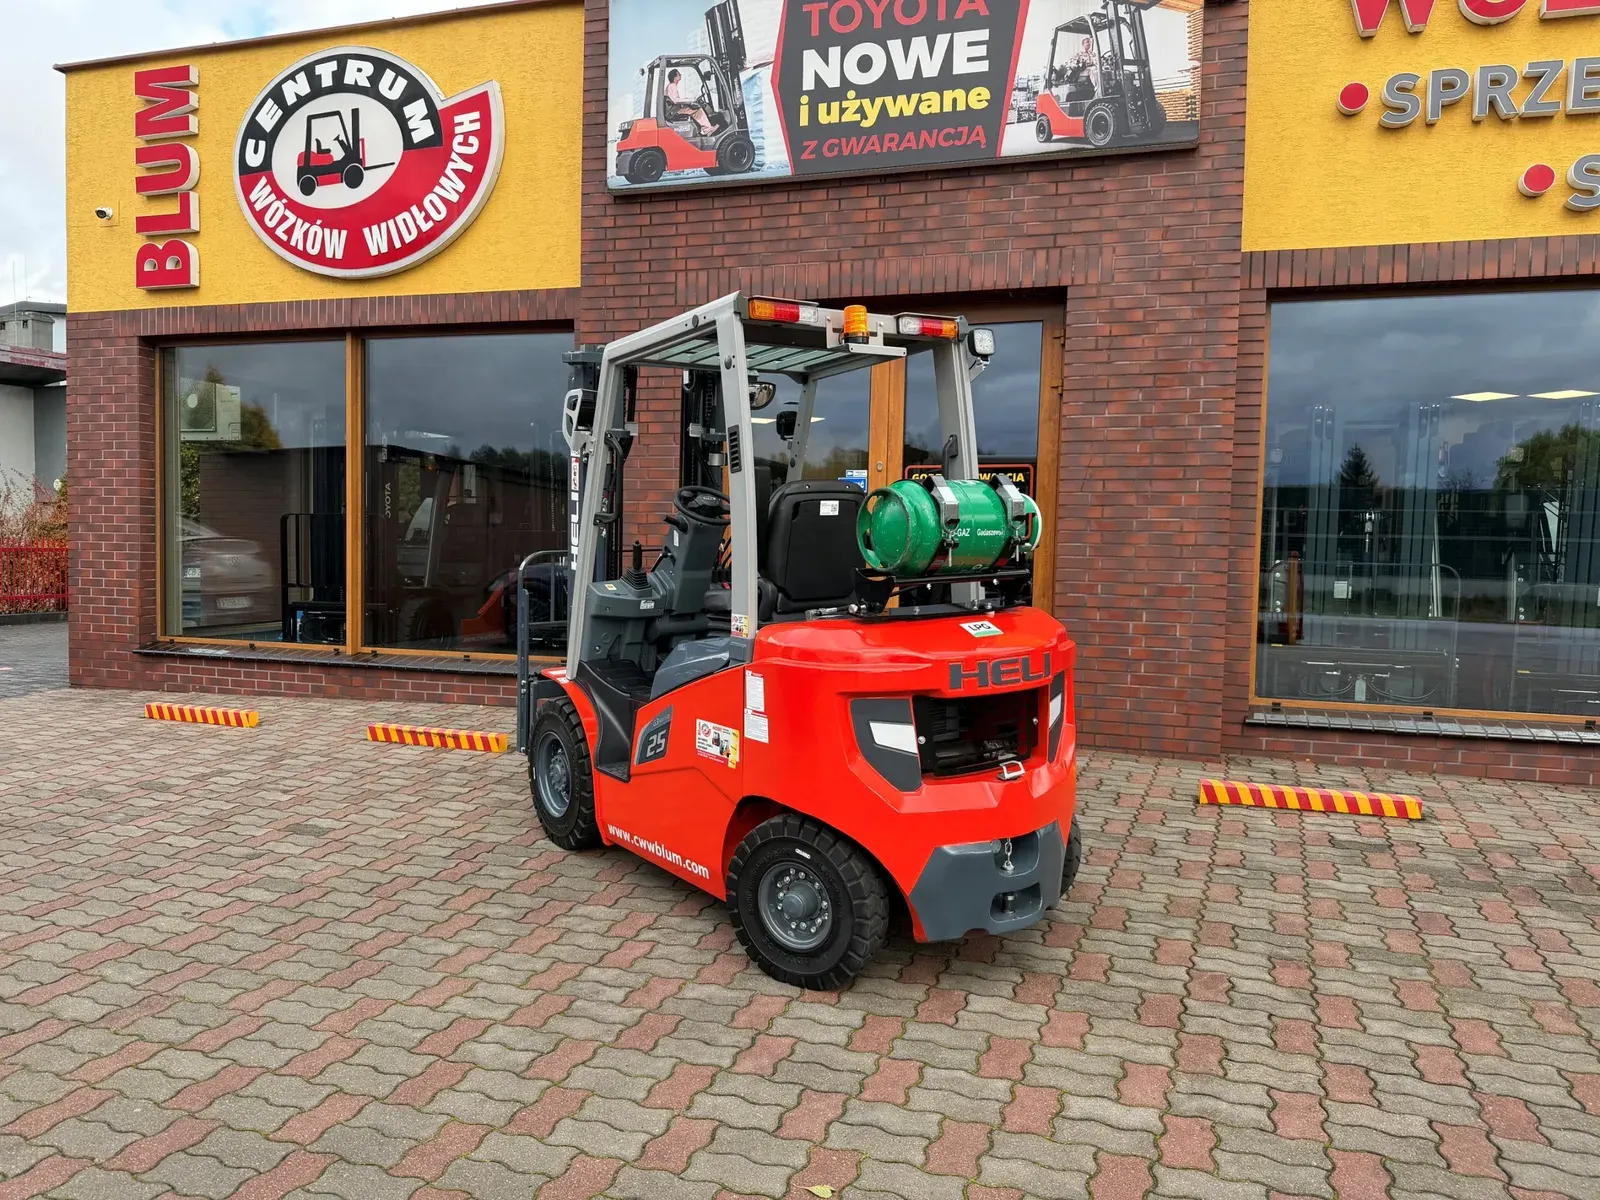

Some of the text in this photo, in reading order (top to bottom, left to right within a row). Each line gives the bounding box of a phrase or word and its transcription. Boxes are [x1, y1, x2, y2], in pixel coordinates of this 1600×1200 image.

[802, 0, 989, 36] TOYOTA
[802, 28, 990, 91] NOWE
[245, 58, 436, 167] CENTRUM
[799, 86, 991, 128] i używane
[1378, 56, 1600, 128] SPRZE
[800, 125, 987, 160] Z GWARANCJĄ
[135, 64, 198, 291] BLUM
[248, 111, 481, 260] WÓZKÓW WIDŁOWYCH
[571, 491, 579, 571] HELI
[968, 623, 991, 632] LPG
[949, 651, 1051, 691] HELI
[646, 729, 667, 758] 25
[607, 823, 710, 880] www.cwwblum.com
